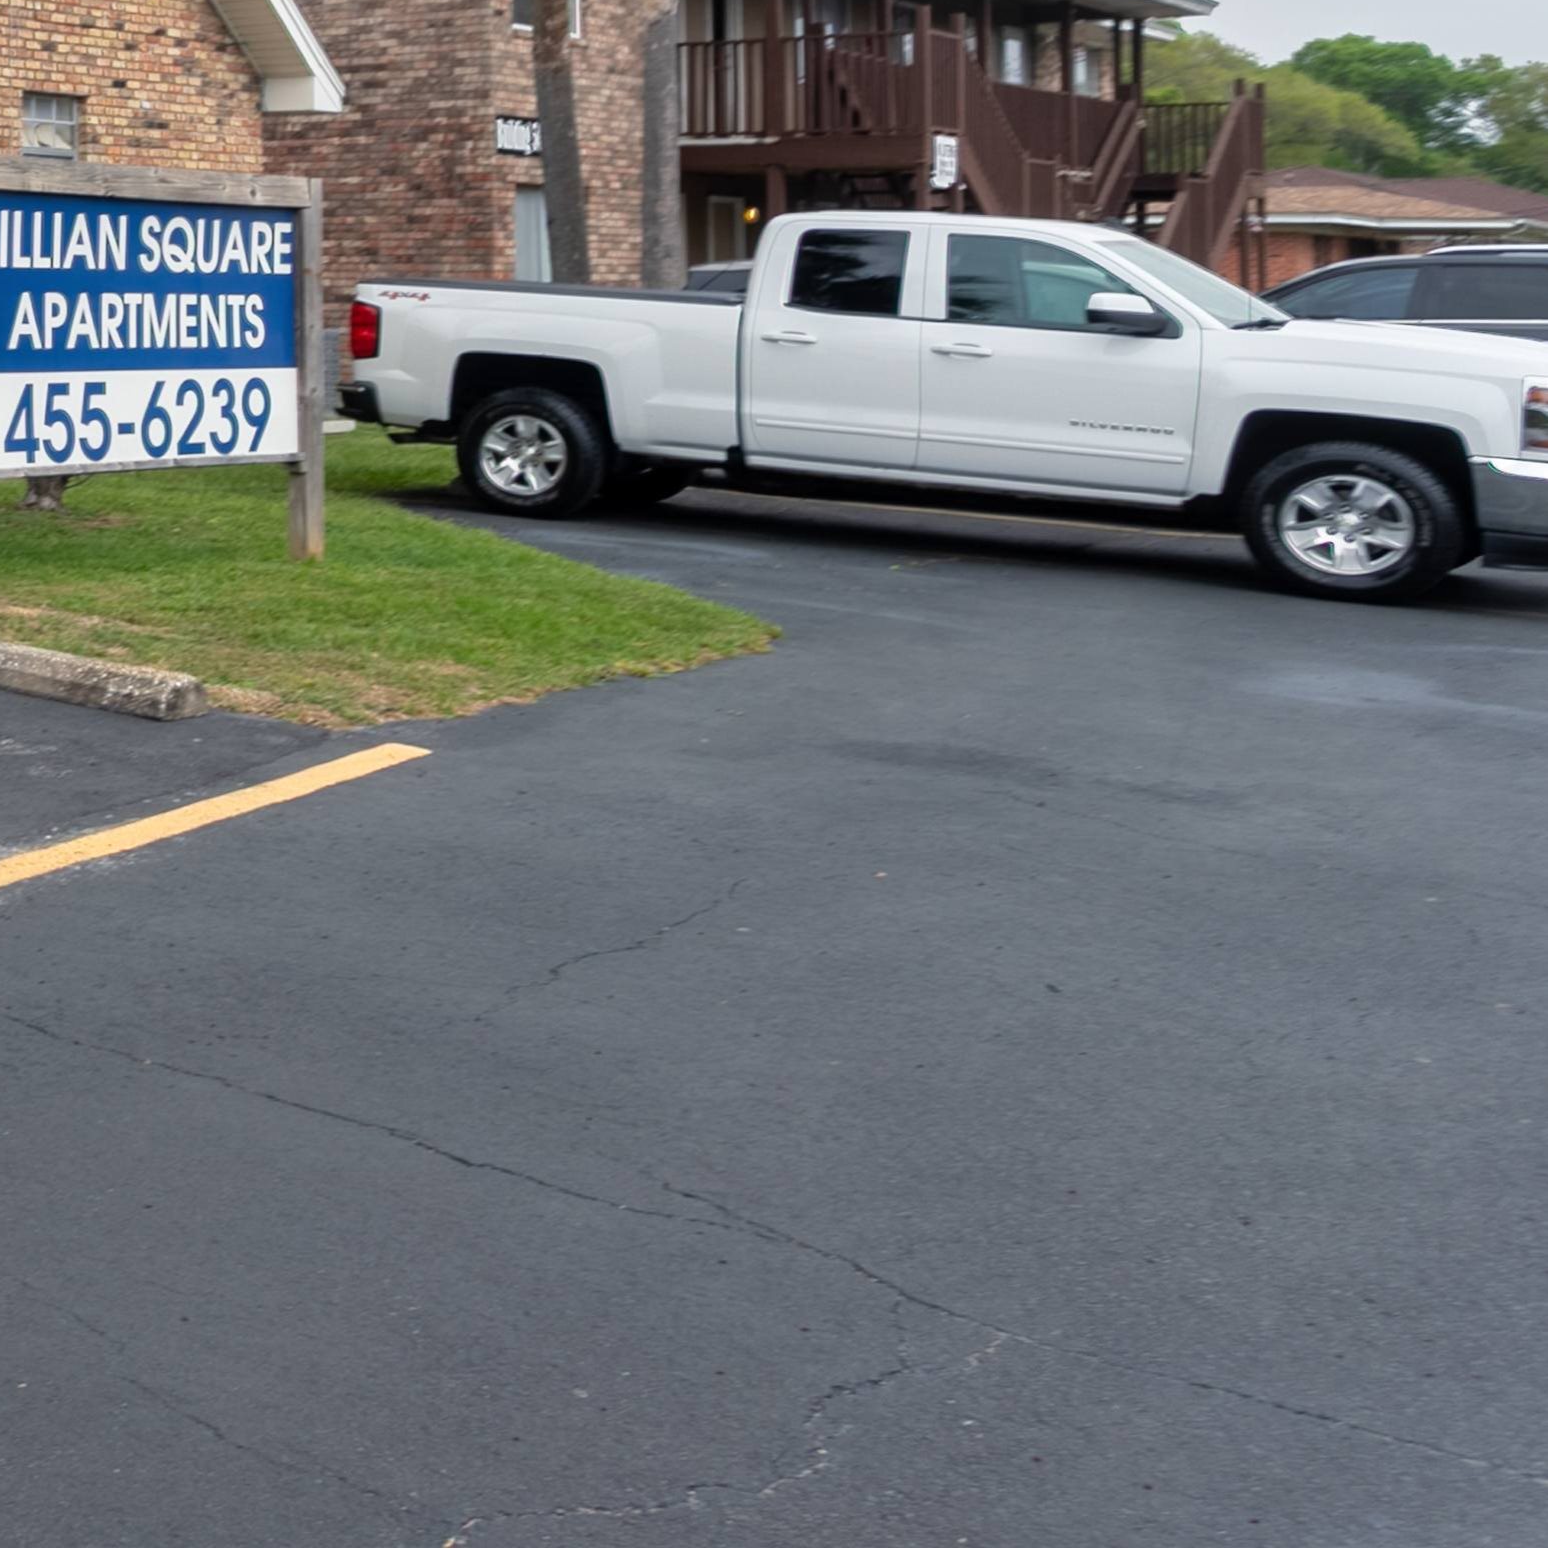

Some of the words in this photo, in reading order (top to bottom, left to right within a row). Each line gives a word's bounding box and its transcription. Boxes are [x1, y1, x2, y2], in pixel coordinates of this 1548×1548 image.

[139, 214, 293, 275] SQUARE
[8, 291, 266, 350] APARTMENTS
[4, 377, 272, 464] 455-6239
